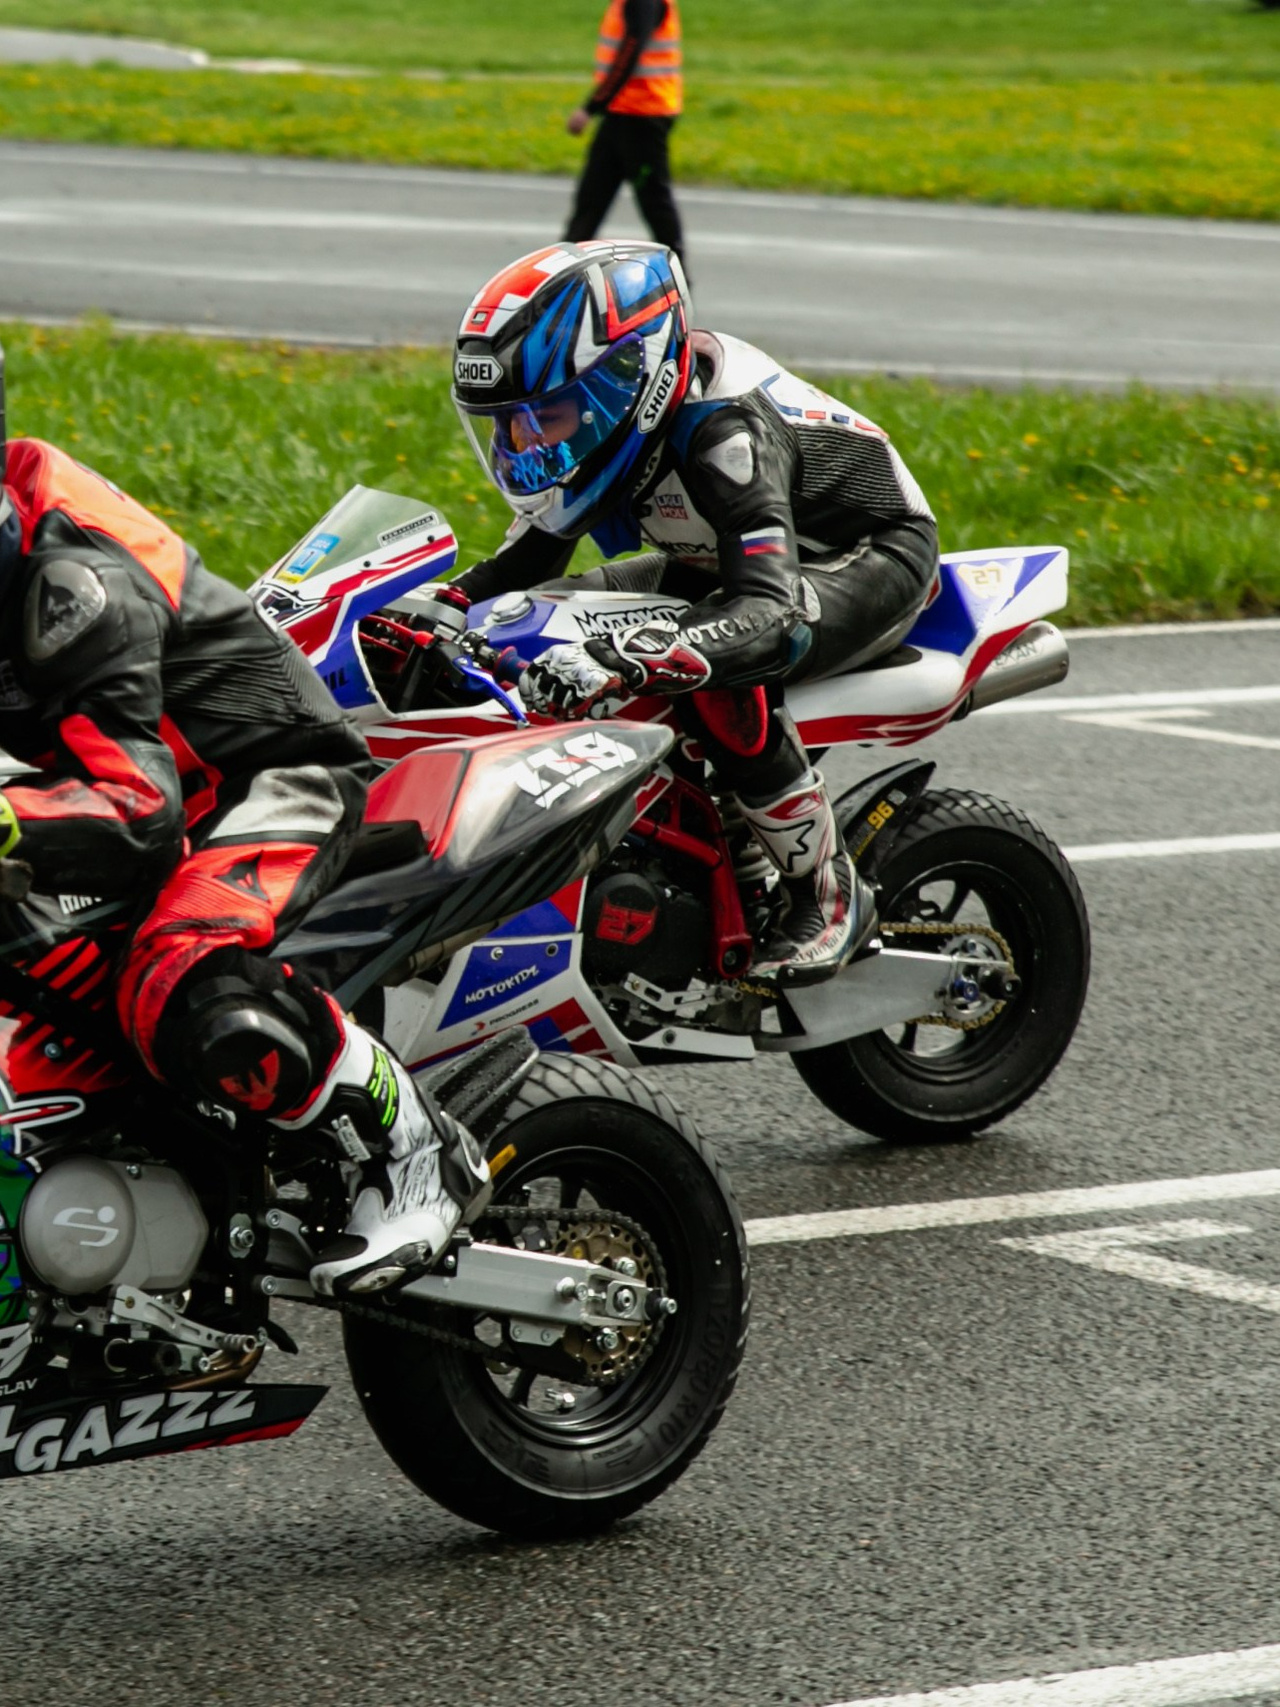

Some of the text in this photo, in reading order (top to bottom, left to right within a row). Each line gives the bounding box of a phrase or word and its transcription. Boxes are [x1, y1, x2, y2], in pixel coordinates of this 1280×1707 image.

[458, 361, 493, 381] SHOEI
[644, 368, 674, 424] SHOEI
[972, 569, 1001, 585] 27
